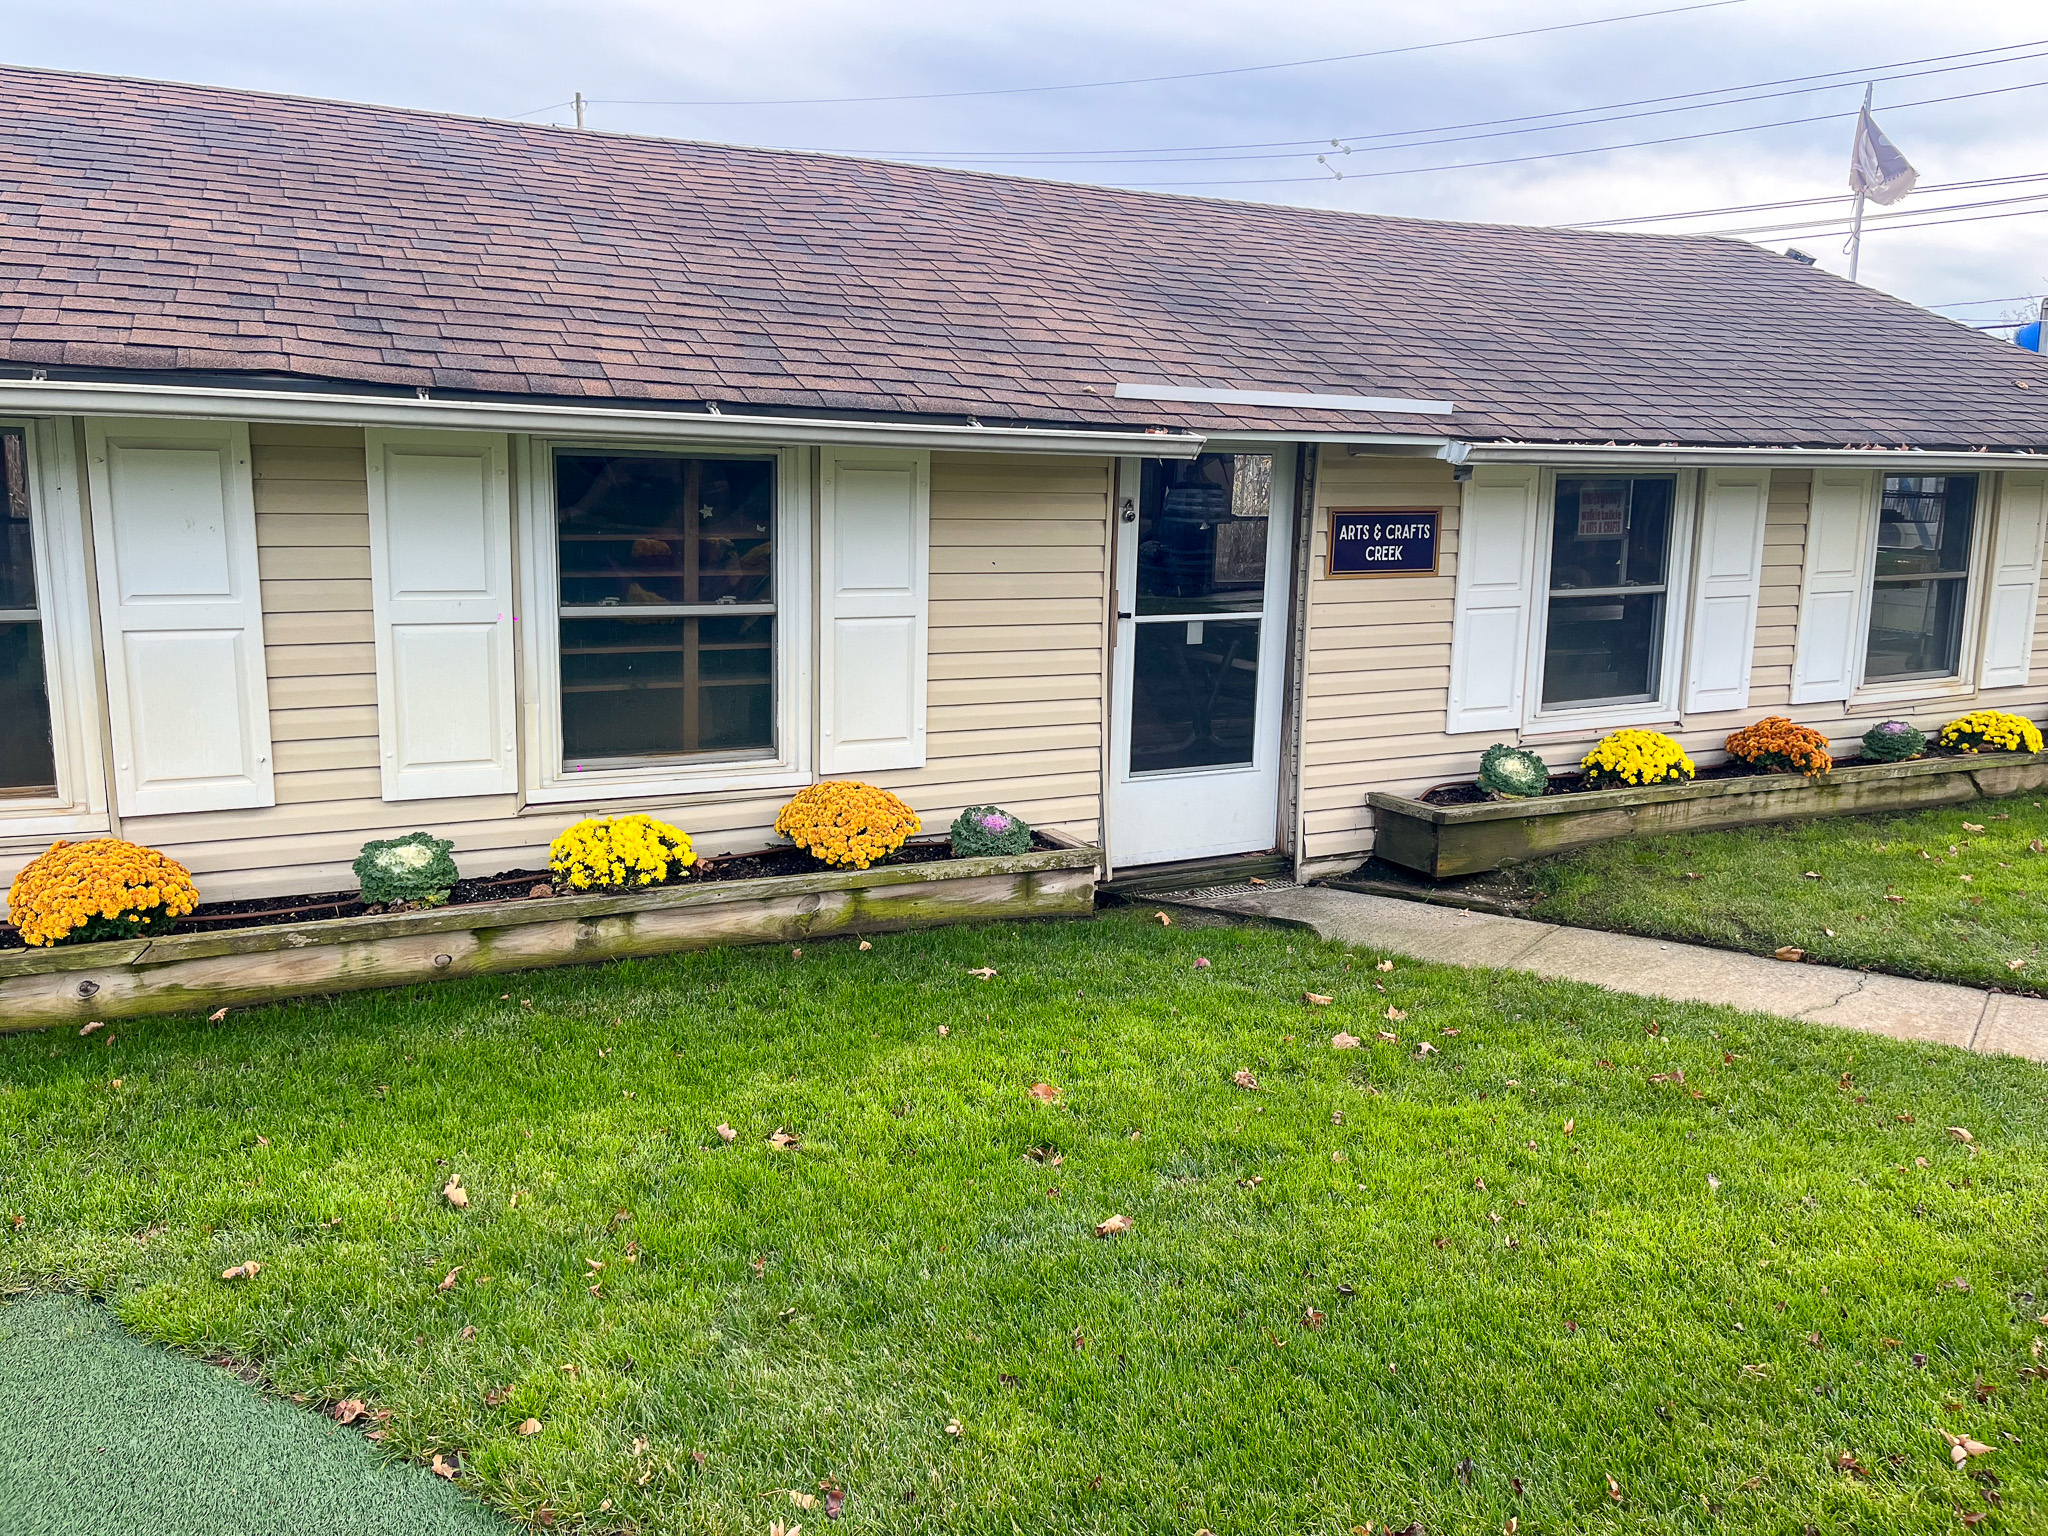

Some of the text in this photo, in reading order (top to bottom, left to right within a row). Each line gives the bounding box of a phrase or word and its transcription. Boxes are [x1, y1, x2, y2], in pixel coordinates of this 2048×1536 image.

[1339, 523, 1431, 541] ARTS & CRAFTS
[1365, 545, 1404, 561] CREEK
